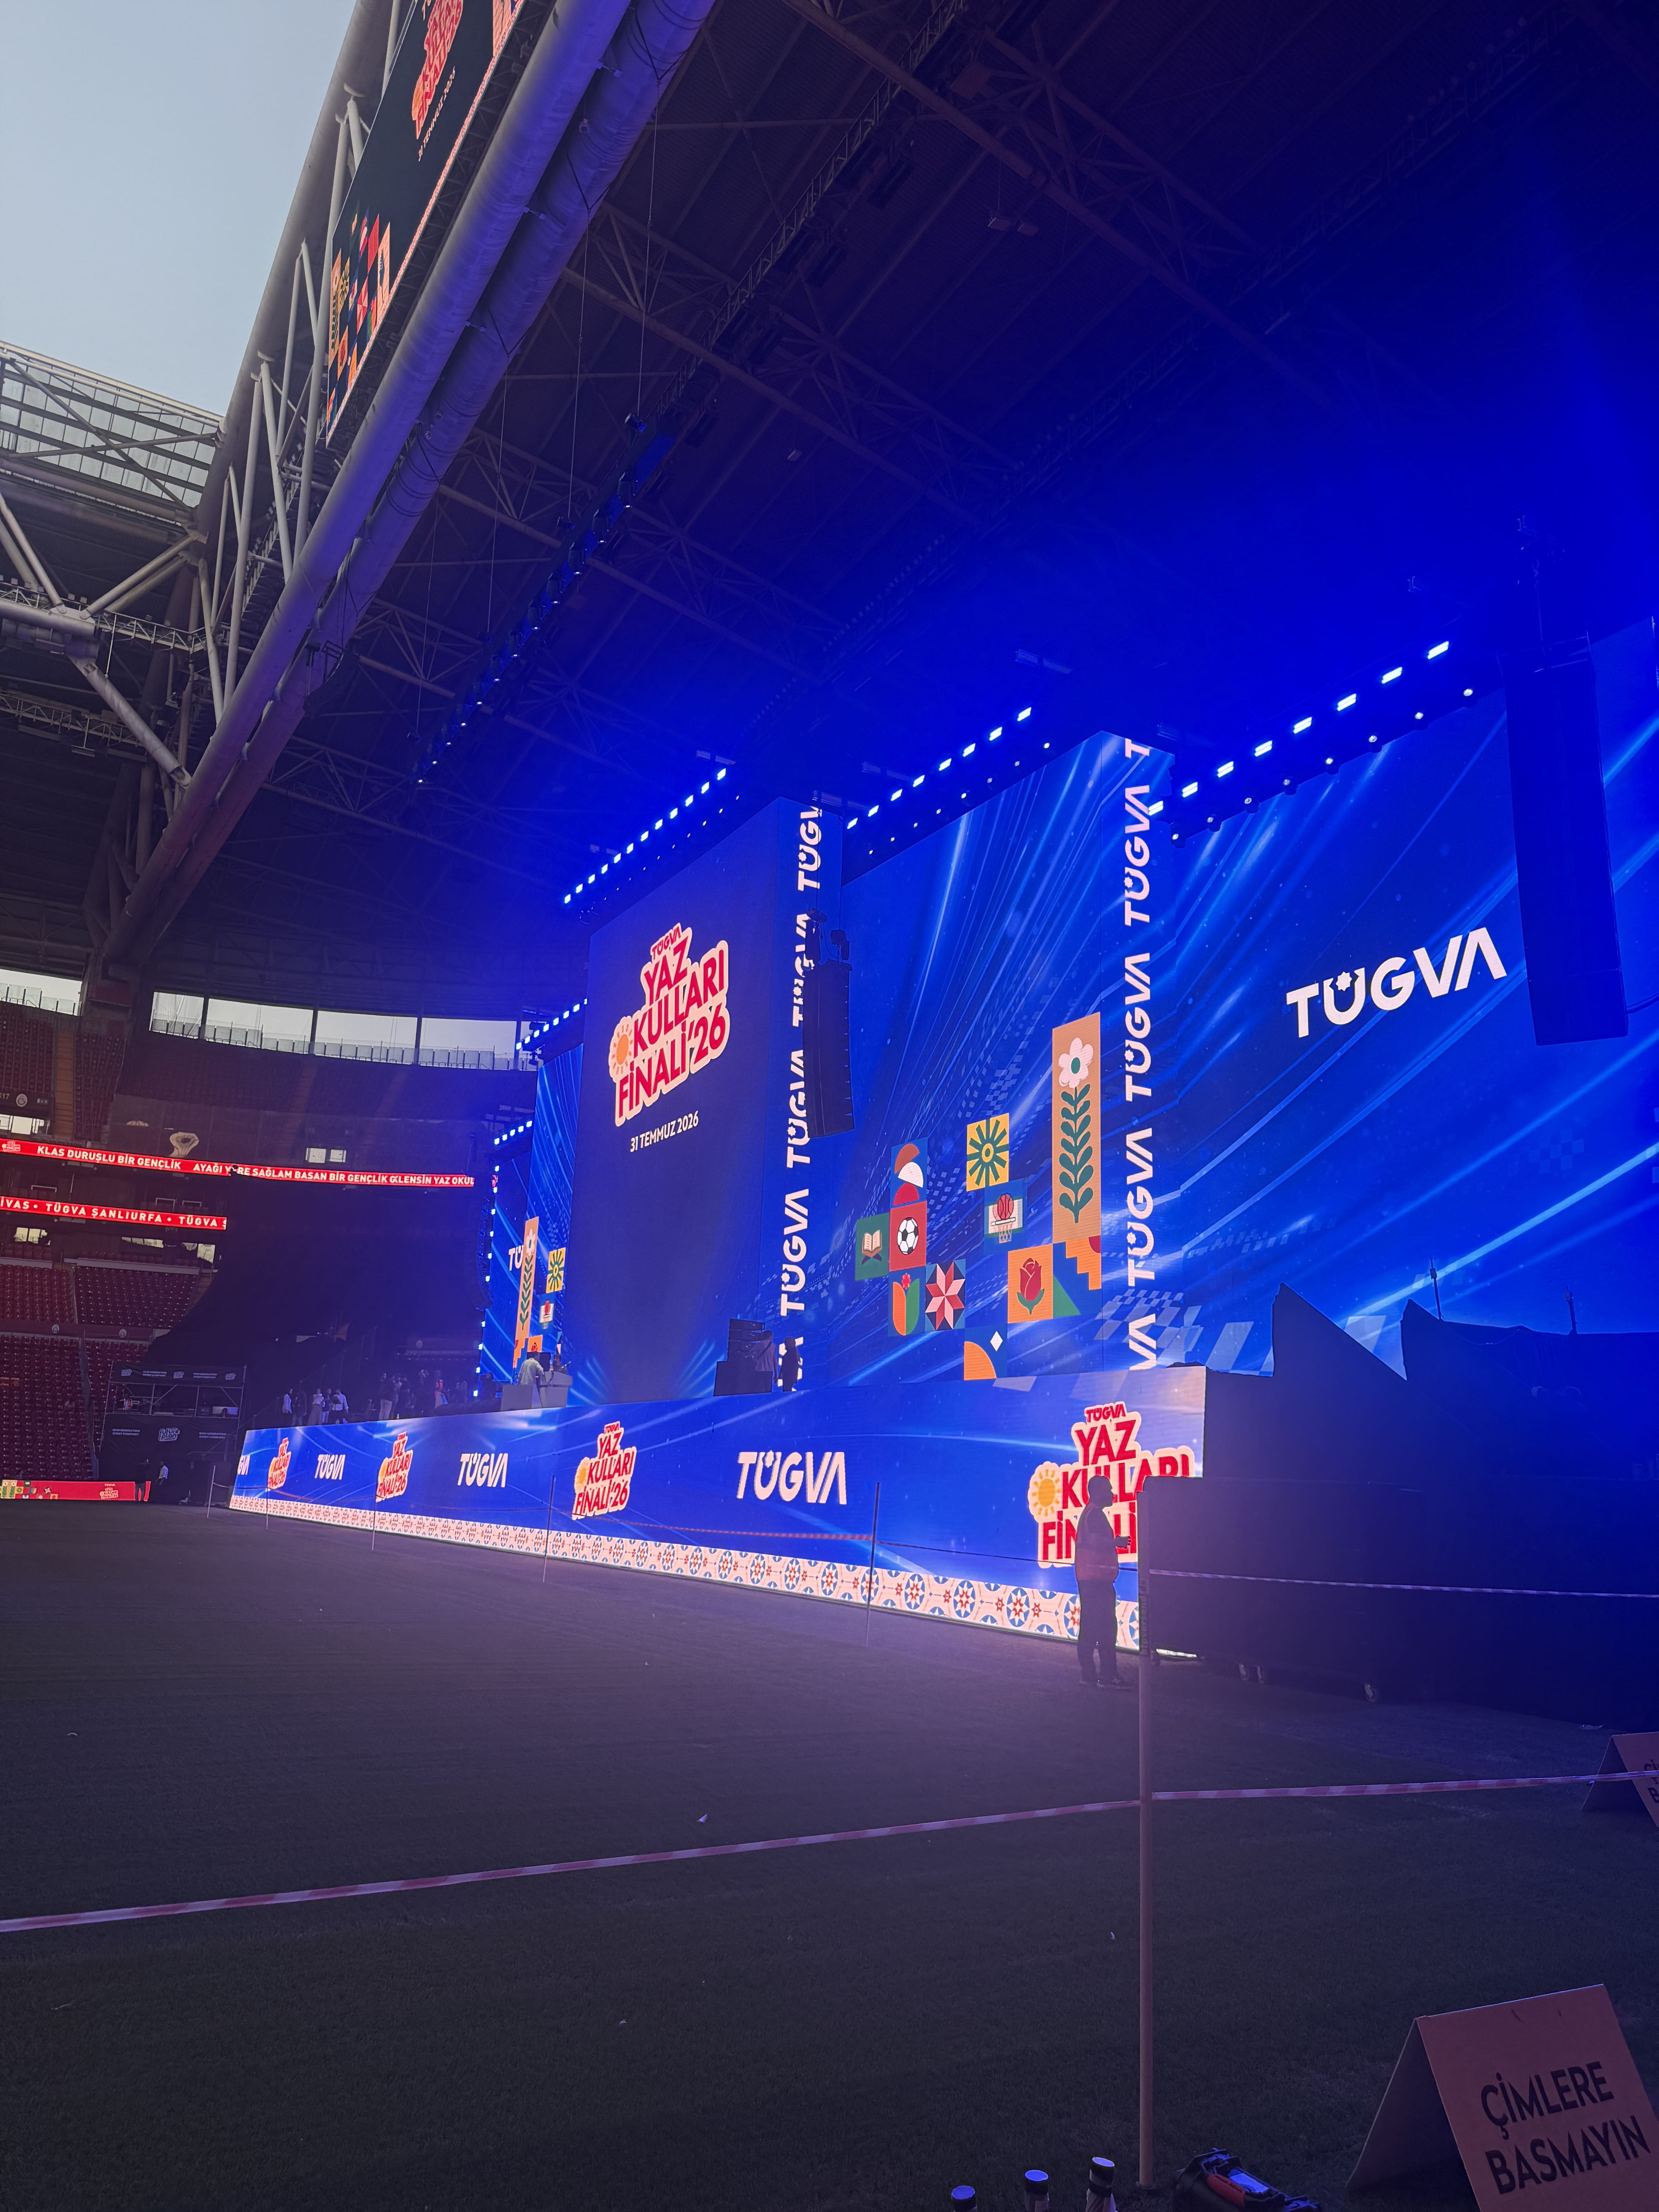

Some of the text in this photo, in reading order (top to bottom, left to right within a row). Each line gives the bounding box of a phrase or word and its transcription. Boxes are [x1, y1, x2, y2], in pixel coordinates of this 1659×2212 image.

[1124, 785, 1150, 926] TÜGVA
[644, 936, 689, 1006] YAZ
[652, 926, 681, 960] TÜGVA
[1286, 927, 1507, 1038] TÜGVA
[1124, 953, 1151, 1102] TÜGVA
[619, 1002, 726, 1118] FİNALİ'26
[630, 1110, 699, 1152] 31 TEMMUZ 2026
[37, 1146, 64, 1157] KLAS
[67, 1149, 115, 1163] DURUŞLU
[117, 1154, 135, 1165] BİR
[137, 1158, 181, 1170] GENÇLİK
[193, 1163, 223, 1173] AYAĞI
[225, 1165, 251, 1176] YRE
[252, 1167, 292, 1179] SAĞLAM
[294, 1171, 327, 1181] BASAN
[329, 1171, 345, 1182] BİR
[347, 1173, 388, 1185] GENÇLİK
[46, 1202, 86, 1215] TÜGVA
[91, 1208, 161, 1223] ŞANLIURFA
[179, 1214, 218, 1227] TÜGVA
[1126, 1128, 1155, 1286] TÜGVA
[780, 1188, 809, 1316] TÜGVA
[314, 1454, 345, 1480] TÜGVA
[457, 1452, 508, 1487] TÜGVA
[599, 1432, 622, 1460] YAZ
[1075, 1419, 1137, 1466] YAZ
[737, 1450, 847, 1505] TÜGVA
[1480, 2061, 1614, 2140] ÇİMLERE
[1485, 2115, 1651, 2195] BASMAYIN
